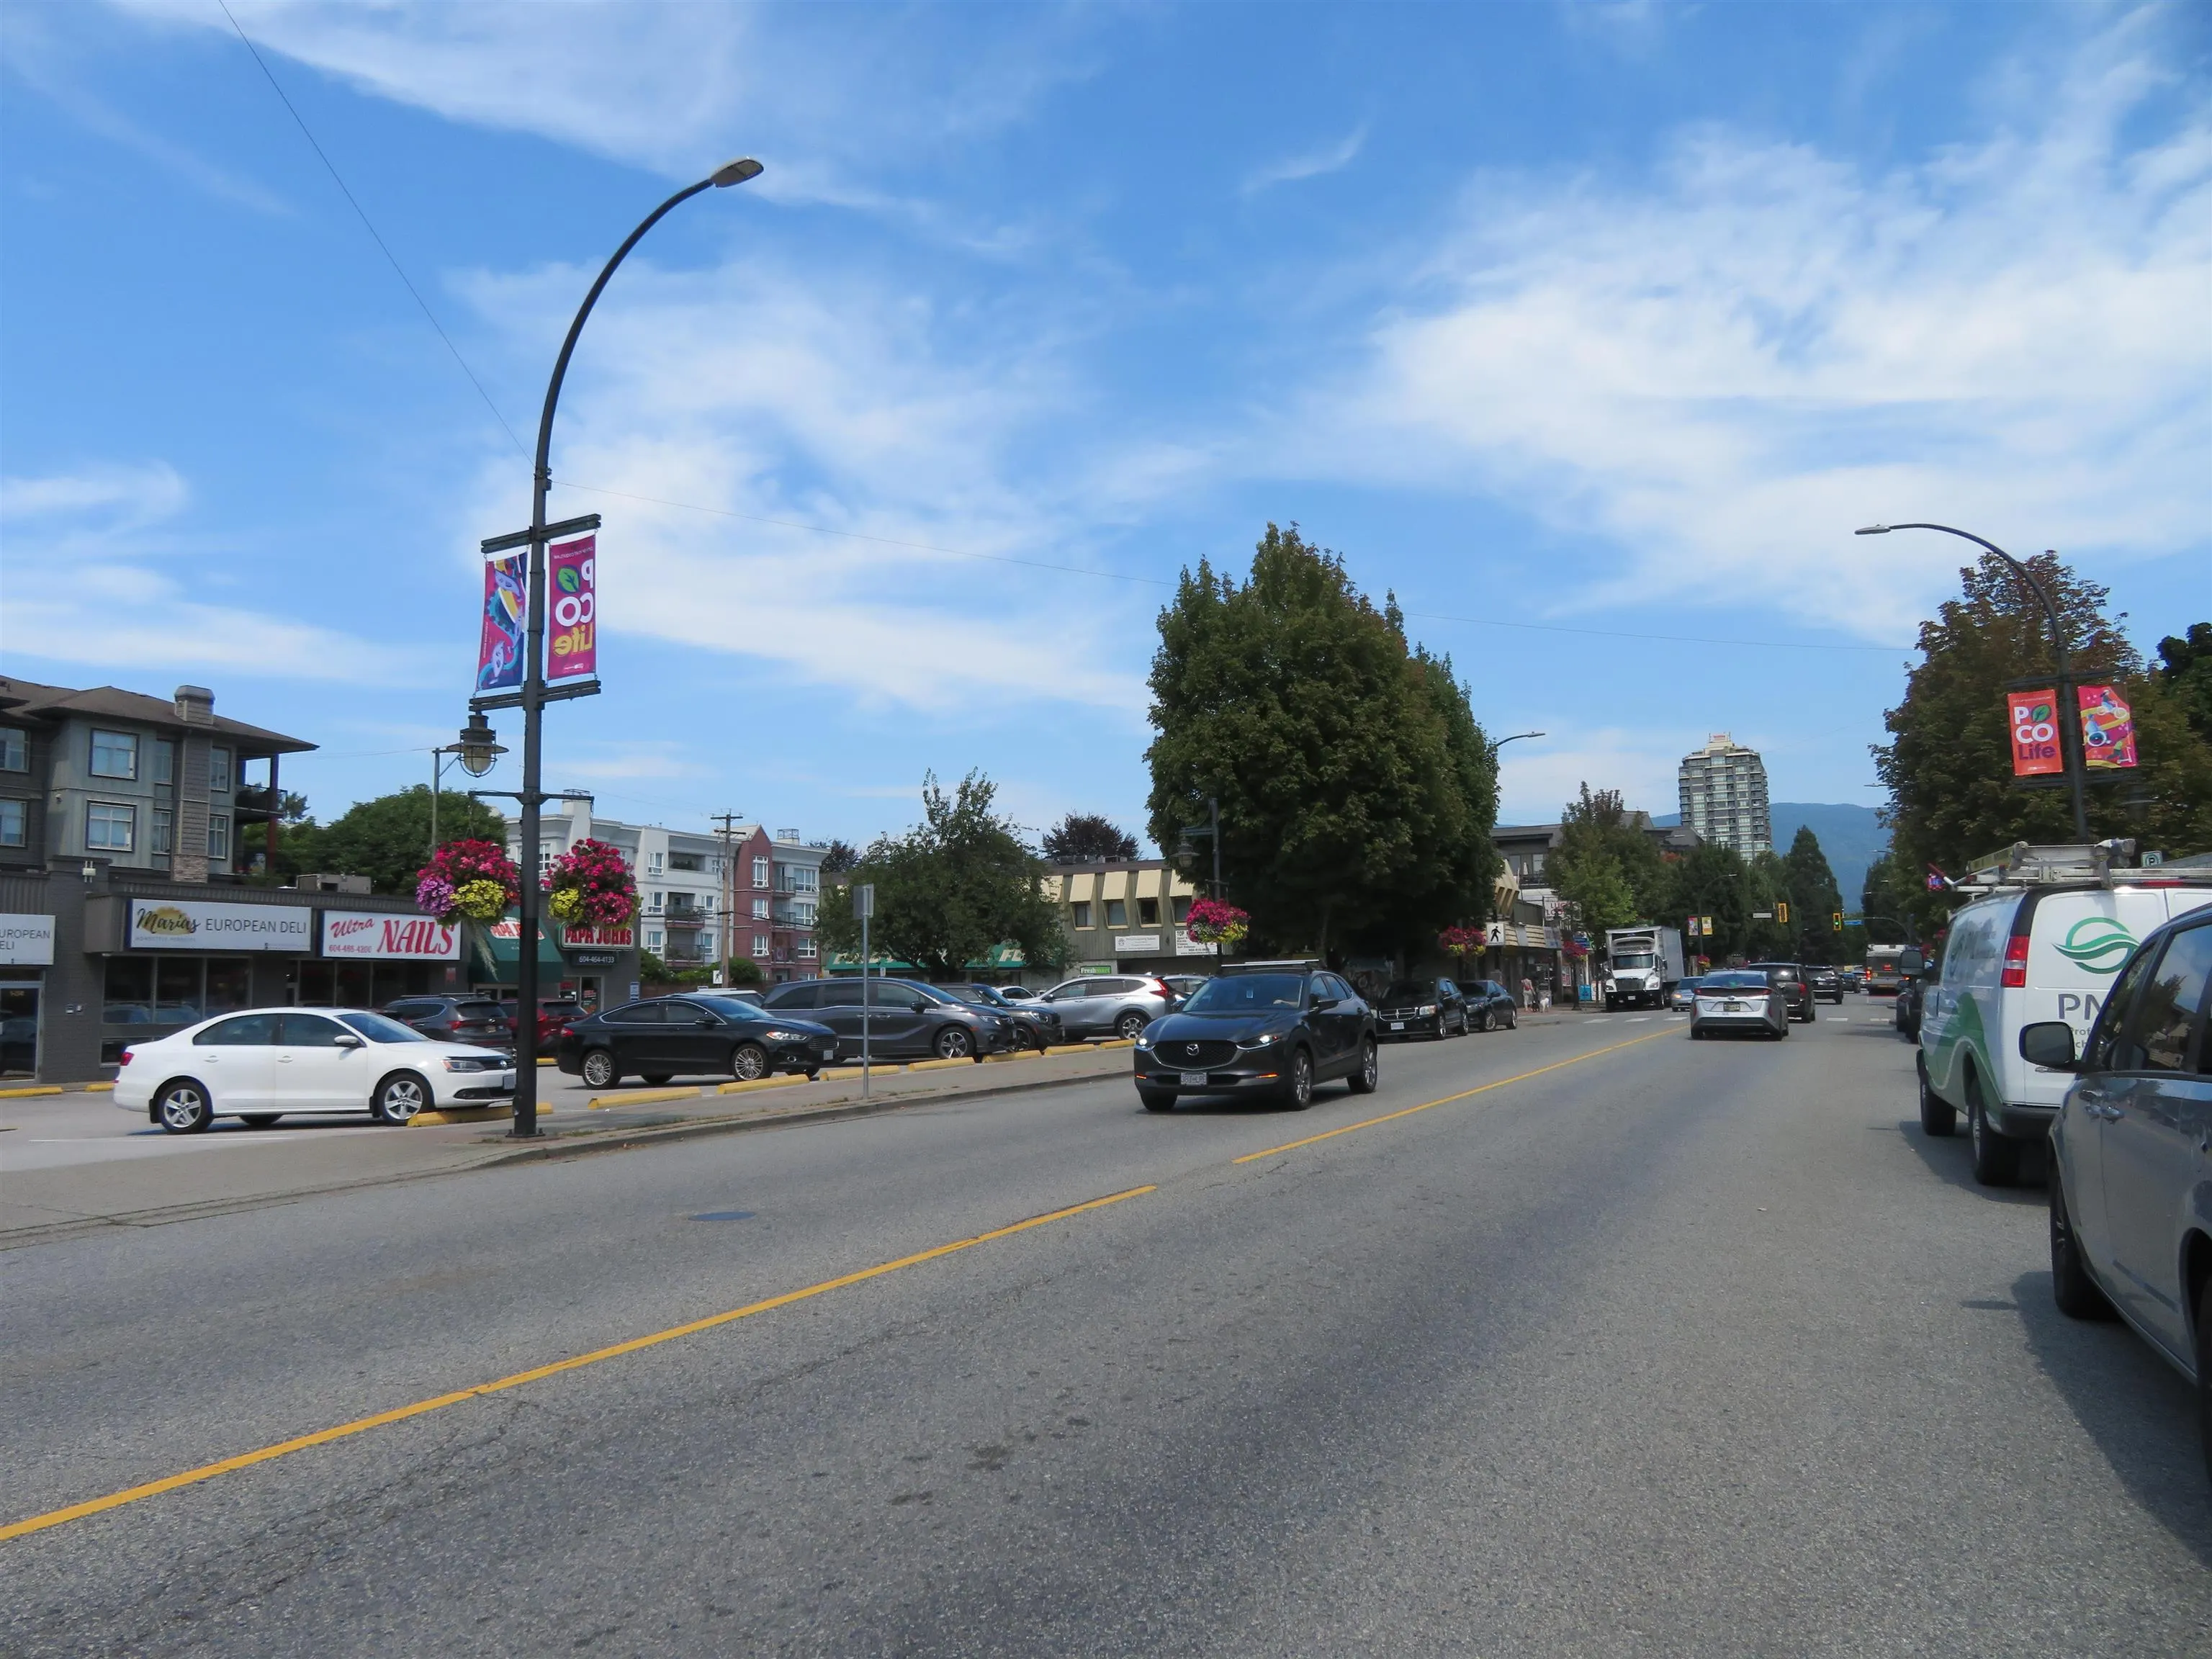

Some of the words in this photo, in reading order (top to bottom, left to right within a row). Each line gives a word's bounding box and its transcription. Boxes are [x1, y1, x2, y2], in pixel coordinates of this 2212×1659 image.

[2016, 723, 2054, 744] CO
[2018, 743, 2056, 760] Life
[0, 929, 50, 939] UROPEAN
[205, 918, 276, 933] EUROPEAN
[279, 921, 307, 934] DELI
[330, 918, 374, 938] Ultra
[377, 920, 455, 956] NAILS
[565, 926, 594, 944] PAPA
[0, 940, 14, 950] ELI
